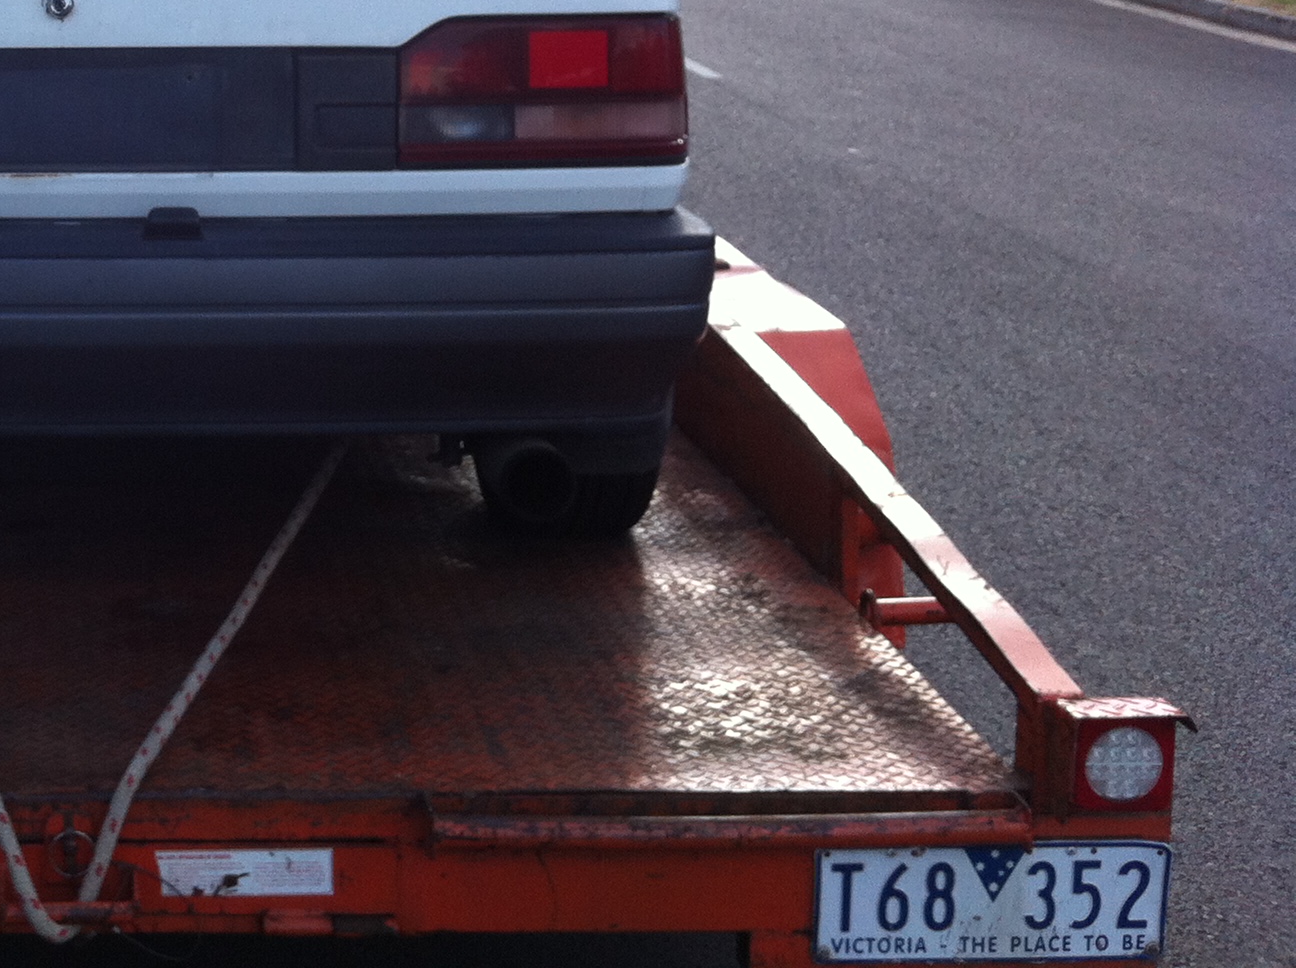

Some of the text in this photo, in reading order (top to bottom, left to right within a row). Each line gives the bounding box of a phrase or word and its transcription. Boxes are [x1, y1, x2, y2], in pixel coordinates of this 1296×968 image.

[830, 859, 1152, 933] T68 352
[830, 936, 928, 954] VICTORIA
[960, 935, 999, 953] THE
[1010, 934, 1072, 952] PLACE
[1083, 934, 1109, 951] TO
[1121, 933, 1147, 950] BE
